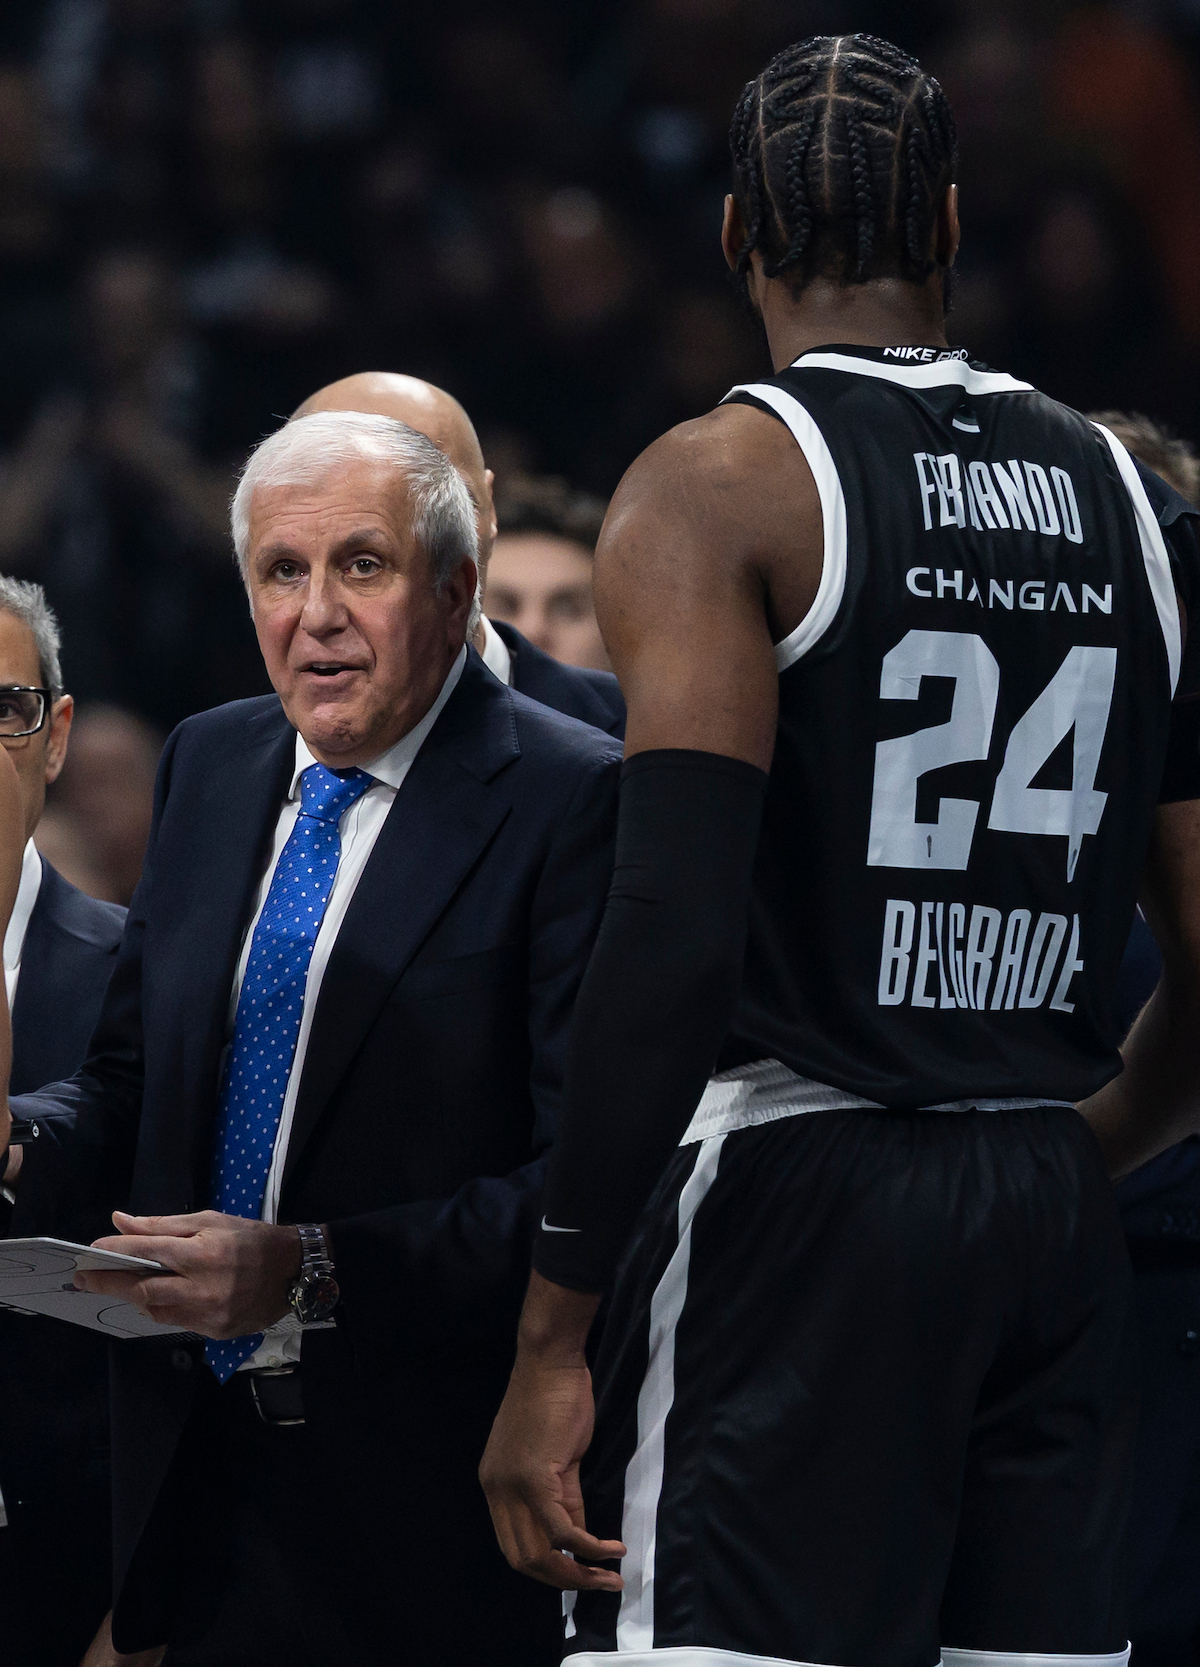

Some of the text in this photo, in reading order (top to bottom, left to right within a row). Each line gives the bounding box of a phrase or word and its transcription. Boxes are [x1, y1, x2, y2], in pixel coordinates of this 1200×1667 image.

[883, 347, 969, 362] NIKE PRO
[905, 566, 1113, 615] CHANGAN
[867, 629, 1118, 883] 24
[877, 899, 1084, 1014] BELGRADE
